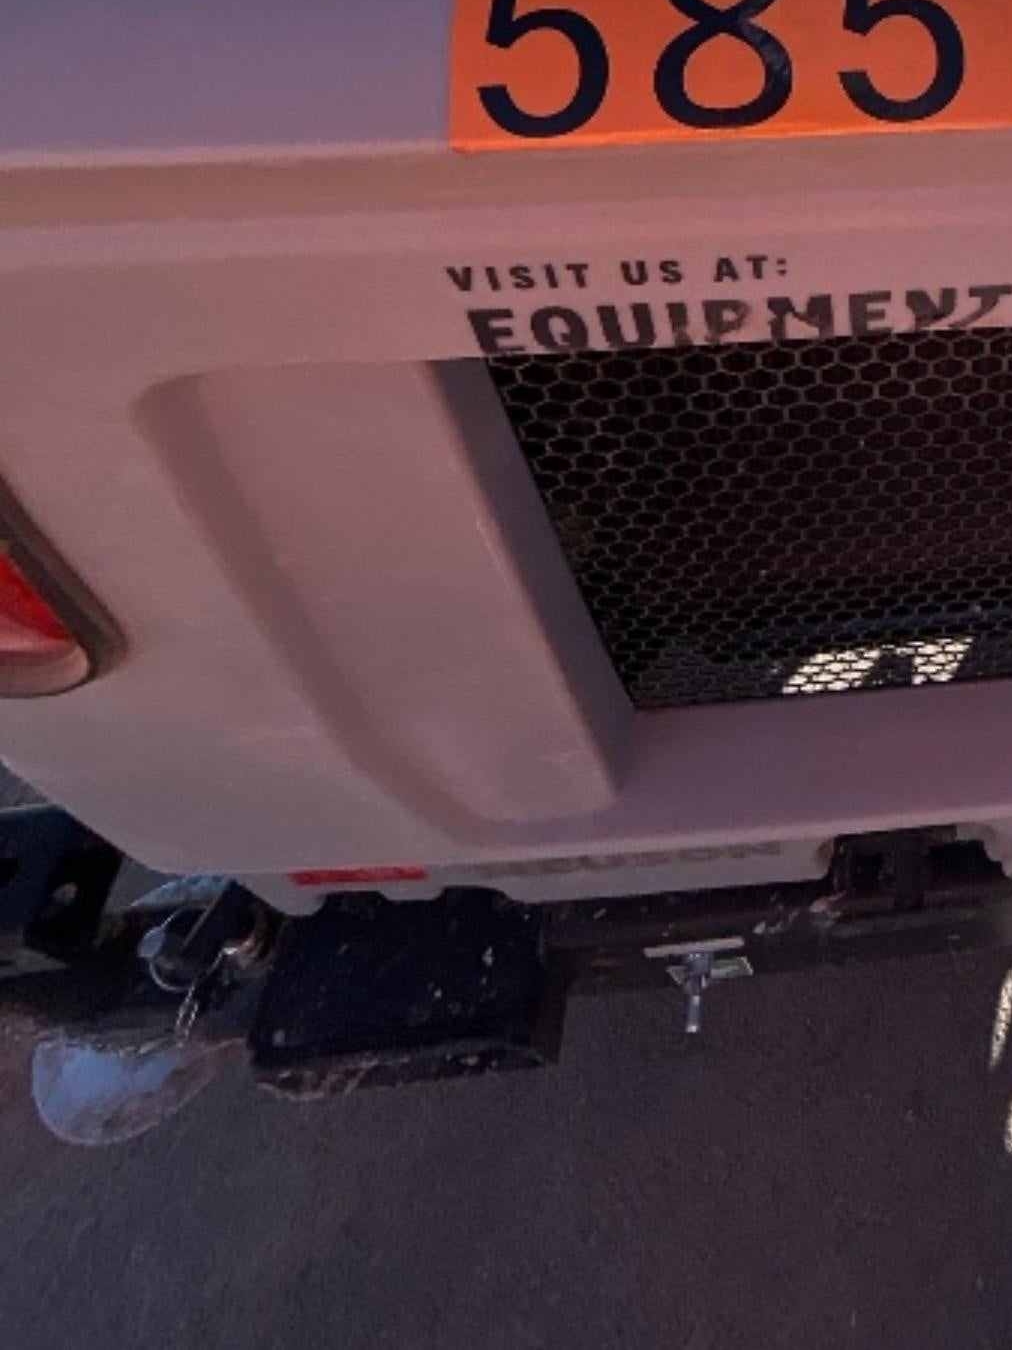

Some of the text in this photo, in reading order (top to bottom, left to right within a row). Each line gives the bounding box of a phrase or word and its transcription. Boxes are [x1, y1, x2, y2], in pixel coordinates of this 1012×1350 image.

[445, 254, 789, 292] VISIT US AT:
